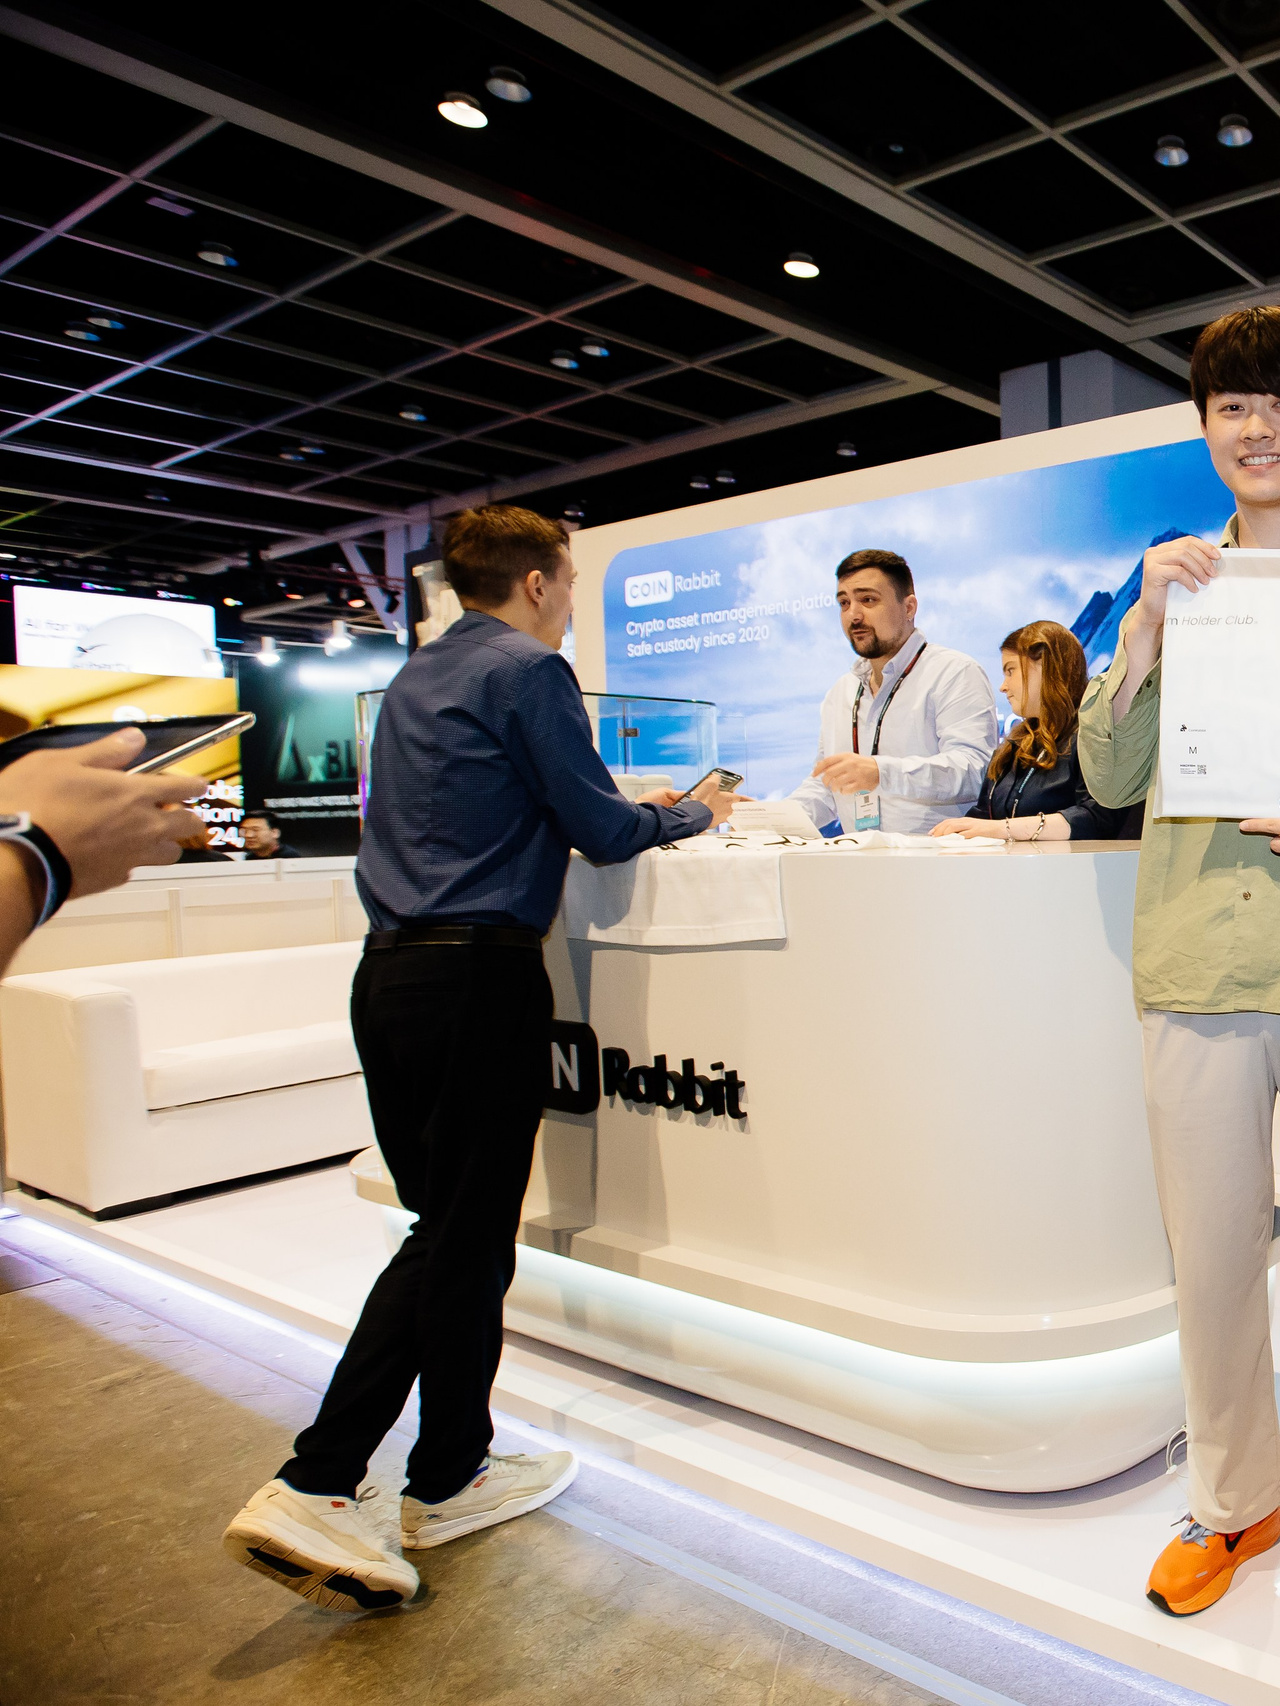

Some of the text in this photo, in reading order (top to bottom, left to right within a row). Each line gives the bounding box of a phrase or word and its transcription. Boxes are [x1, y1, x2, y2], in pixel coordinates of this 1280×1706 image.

[630, 569, 721, 598] COIN Rabbit
[626, 618, 665, 638] Crypto
[666, 613, 700, 631] asset
[701, 602, 789, 628] management
[1182, 615, 1222, 626] Holder
[1225, 614, 1254, 625] Club
[627, 625, 769, 658] Safe custody since 2020
[601, 1046, 748, 1120] Rabbit
